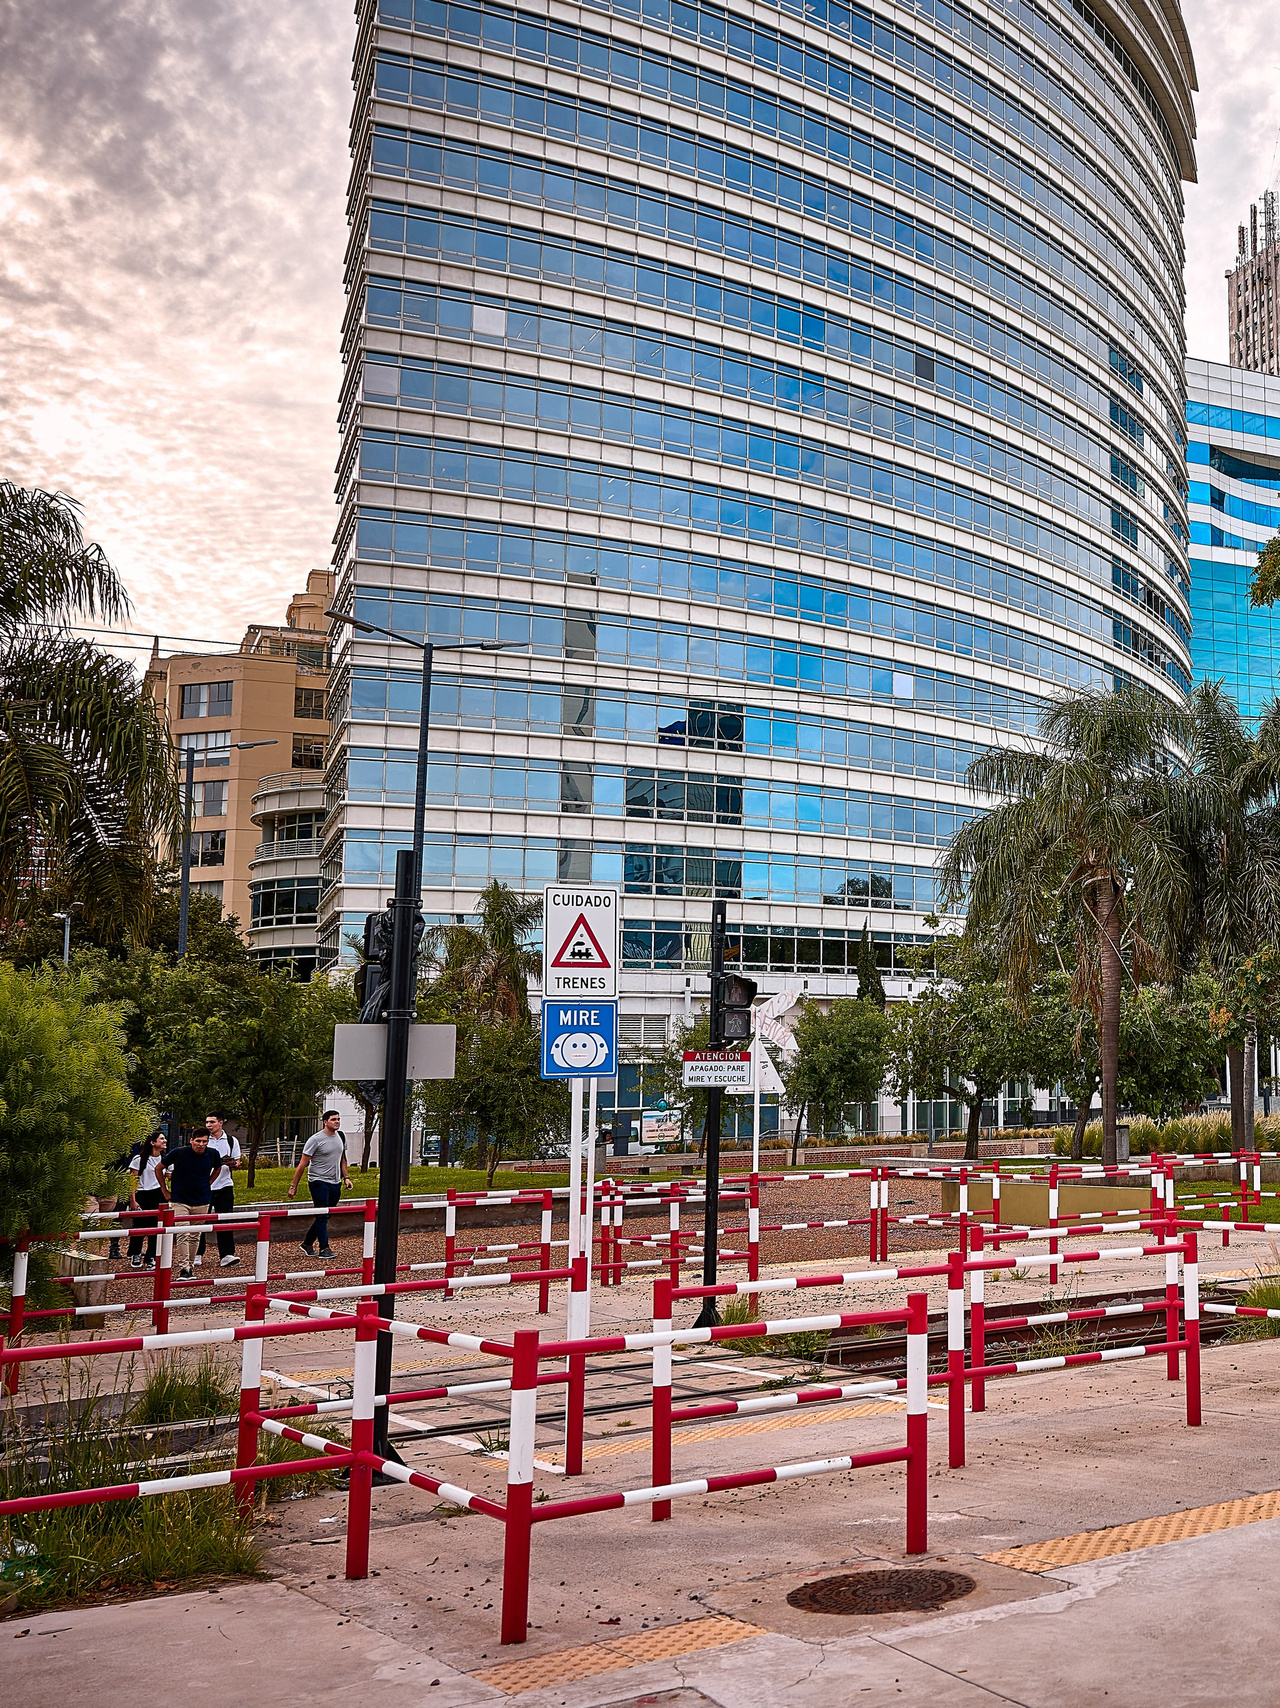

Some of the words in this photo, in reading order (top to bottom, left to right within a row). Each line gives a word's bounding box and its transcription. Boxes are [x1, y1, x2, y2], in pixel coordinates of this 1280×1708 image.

[552, 894, 611, 908] CUIDADO
[555, 977, 606, 989] TRENES
[559, 1010, 600, 1026] MIRE
[694, 1052, 741, 1061] ATENCION
